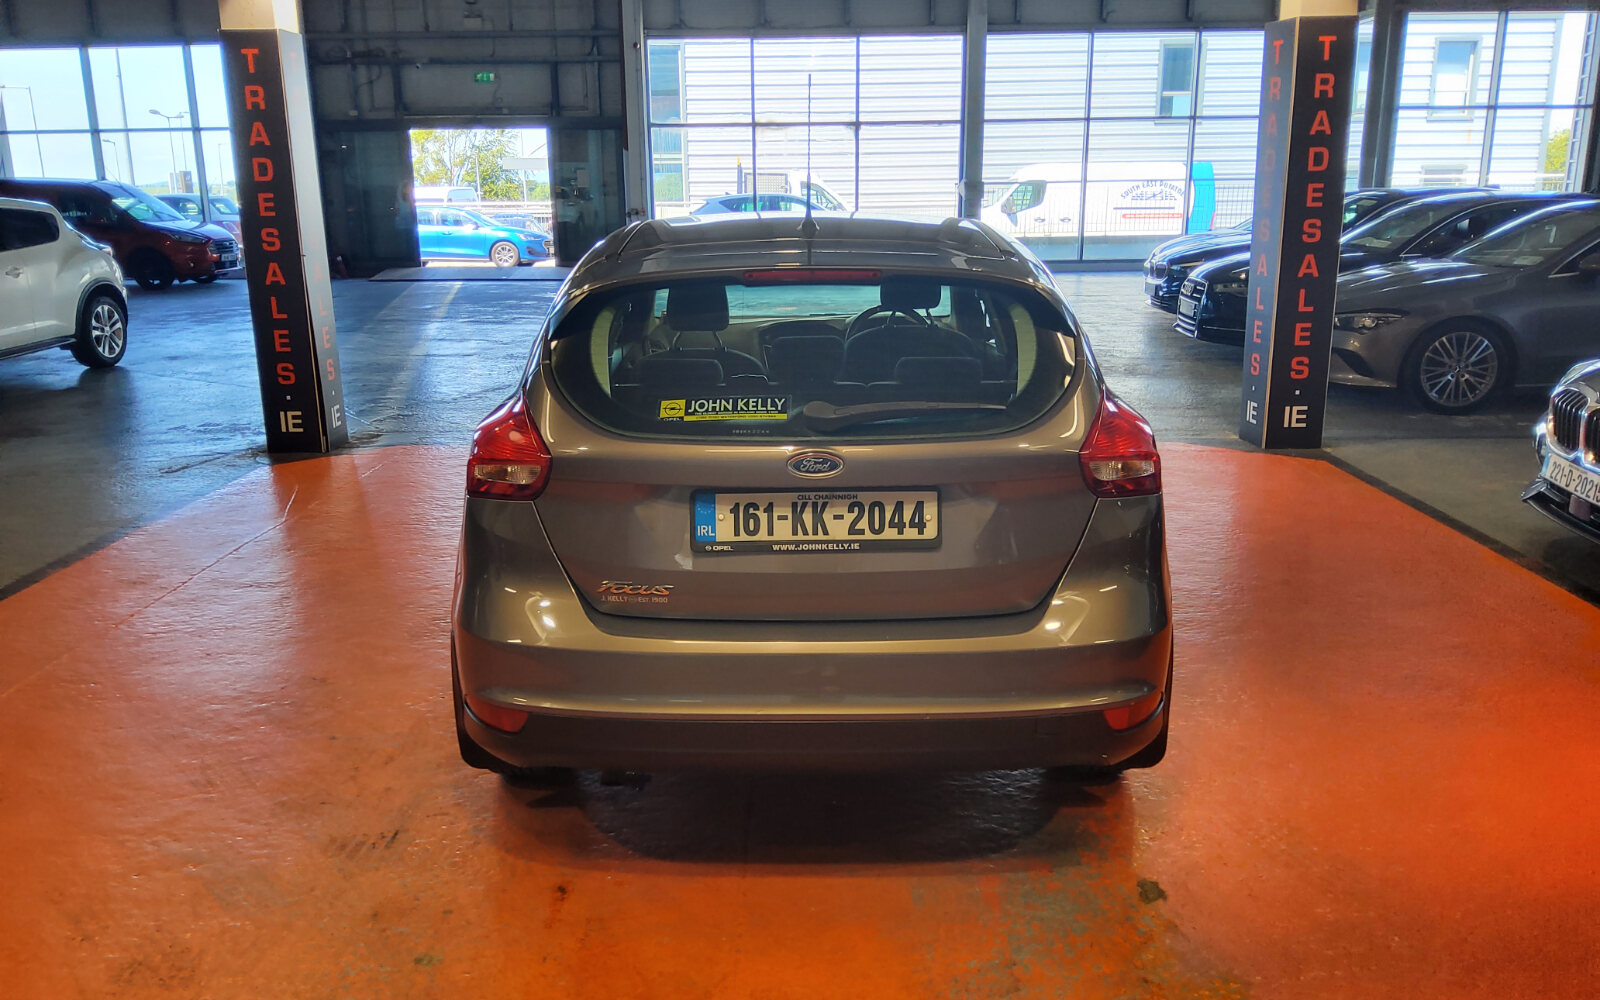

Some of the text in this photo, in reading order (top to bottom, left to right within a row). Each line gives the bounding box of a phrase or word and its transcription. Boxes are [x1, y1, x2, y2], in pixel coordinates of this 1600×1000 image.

[1120, 184, 1140, 199] SOUTH
[1142, 180, 1157, 189] EAST
[688, 398, 786, 413] JOHN KELLY
[800, 458, 831, 472] Ford
[729, 500, 927, 537] 161-KK-2044
[697, 525, 716, 537] IRL
[772, 543, 860, 551] WWW.JOHNKELLY.IE
